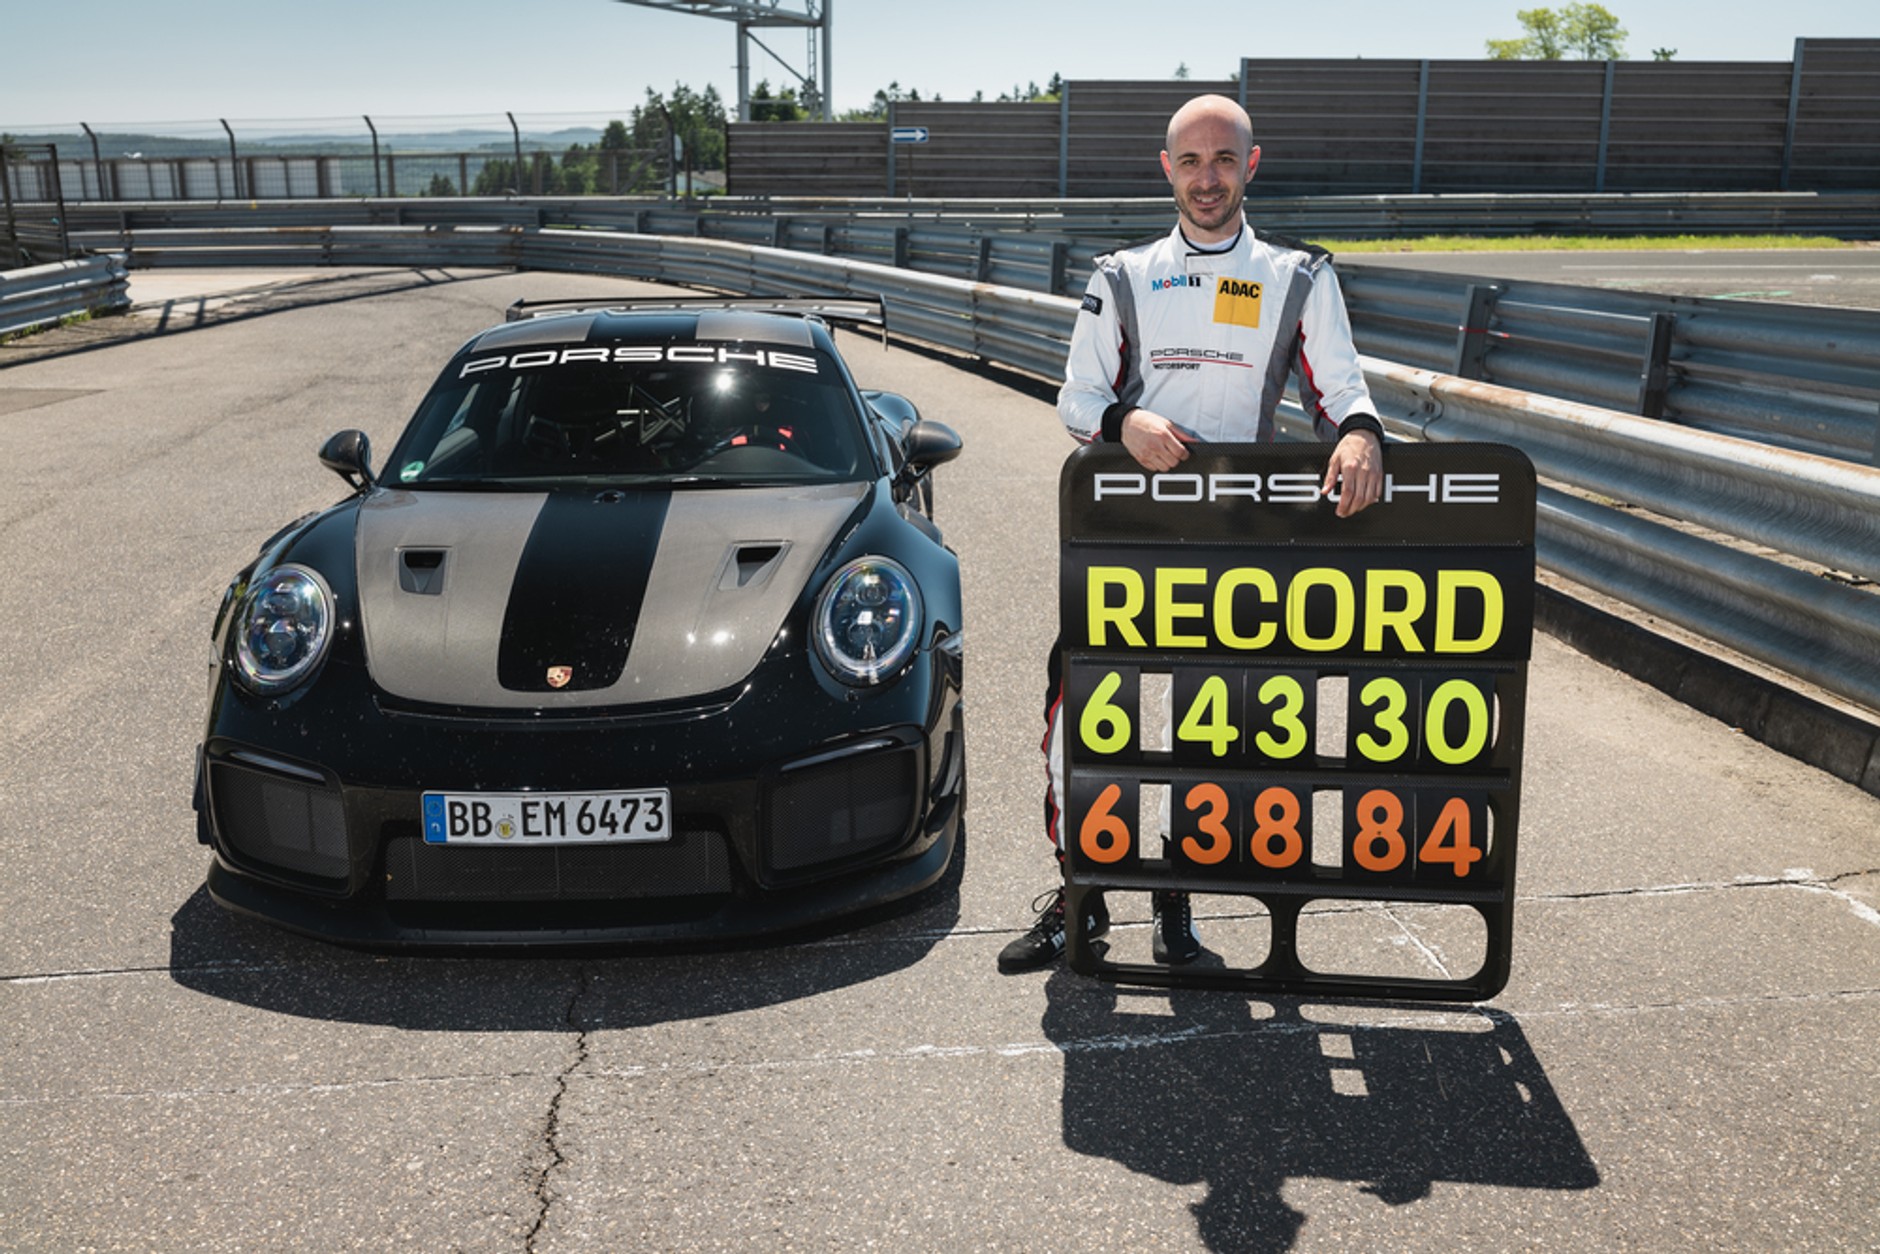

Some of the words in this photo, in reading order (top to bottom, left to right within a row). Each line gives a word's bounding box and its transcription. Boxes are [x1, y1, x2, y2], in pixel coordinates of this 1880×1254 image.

[1152, 275, 1187, 291] Mobil
[1188, 276, 1201, 287] 1
[1219, 280, 1260, 298] ADAC
[459, 346, 819, 379] PORSCHE
[1151, 348, 1244, 361] PORSCHE
[1153, 363, 1200, 371] MOTORSPORT
[1094, 473, 1500, 502] PORSHE
[1087, 566, 1504, 653] RECORD
[1079, 672, 1131, 754] 6
[448, 801, 493, 837] BB
[521, 801, 567, 837] EM
[577, 797, 664, 836] 6473
[1079, 783, 1131, 863] 6
